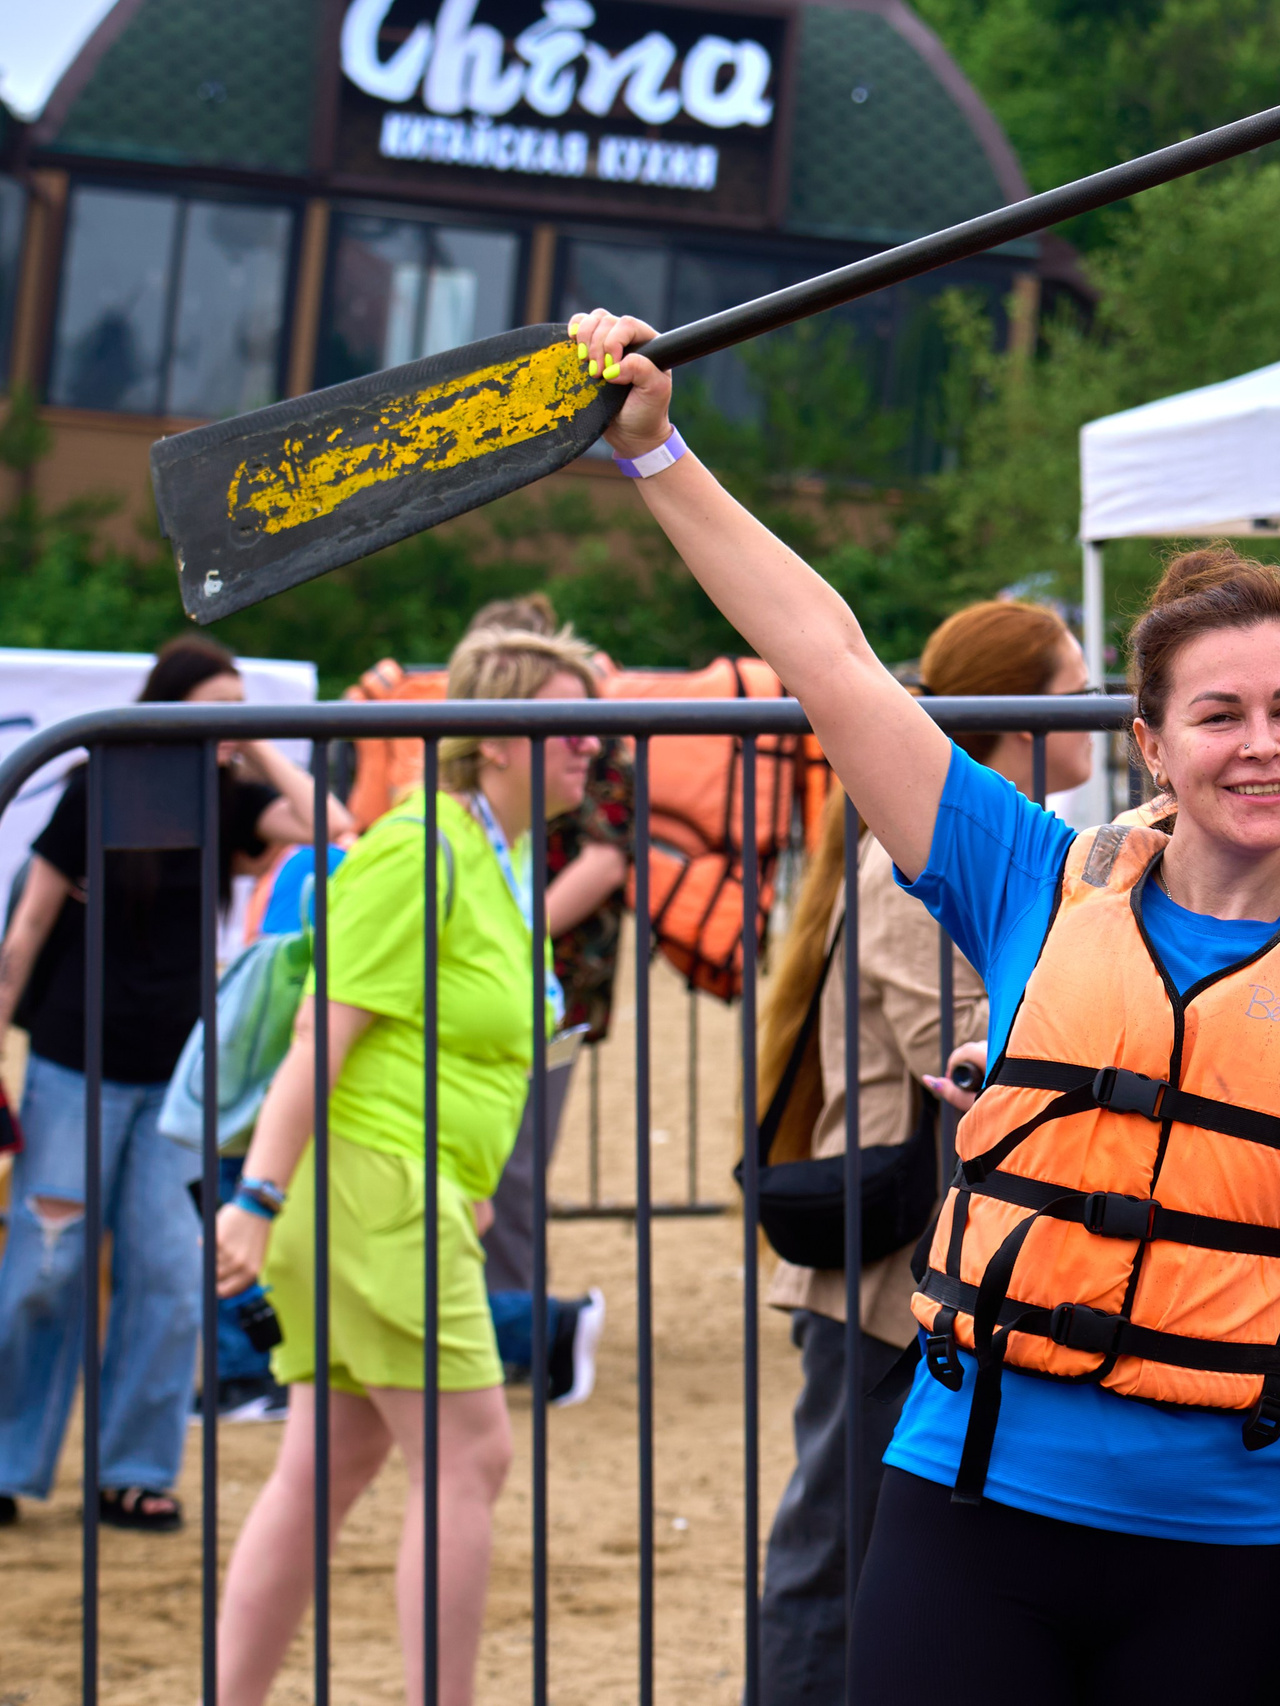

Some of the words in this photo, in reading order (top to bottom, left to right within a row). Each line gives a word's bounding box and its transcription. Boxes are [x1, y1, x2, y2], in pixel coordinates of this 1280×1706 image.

[340, 0, 774, 128] China
[379, 111, 589, 178] КИТАЙСКАЯ
[599, 136, 719, 191] КУХНЯ
